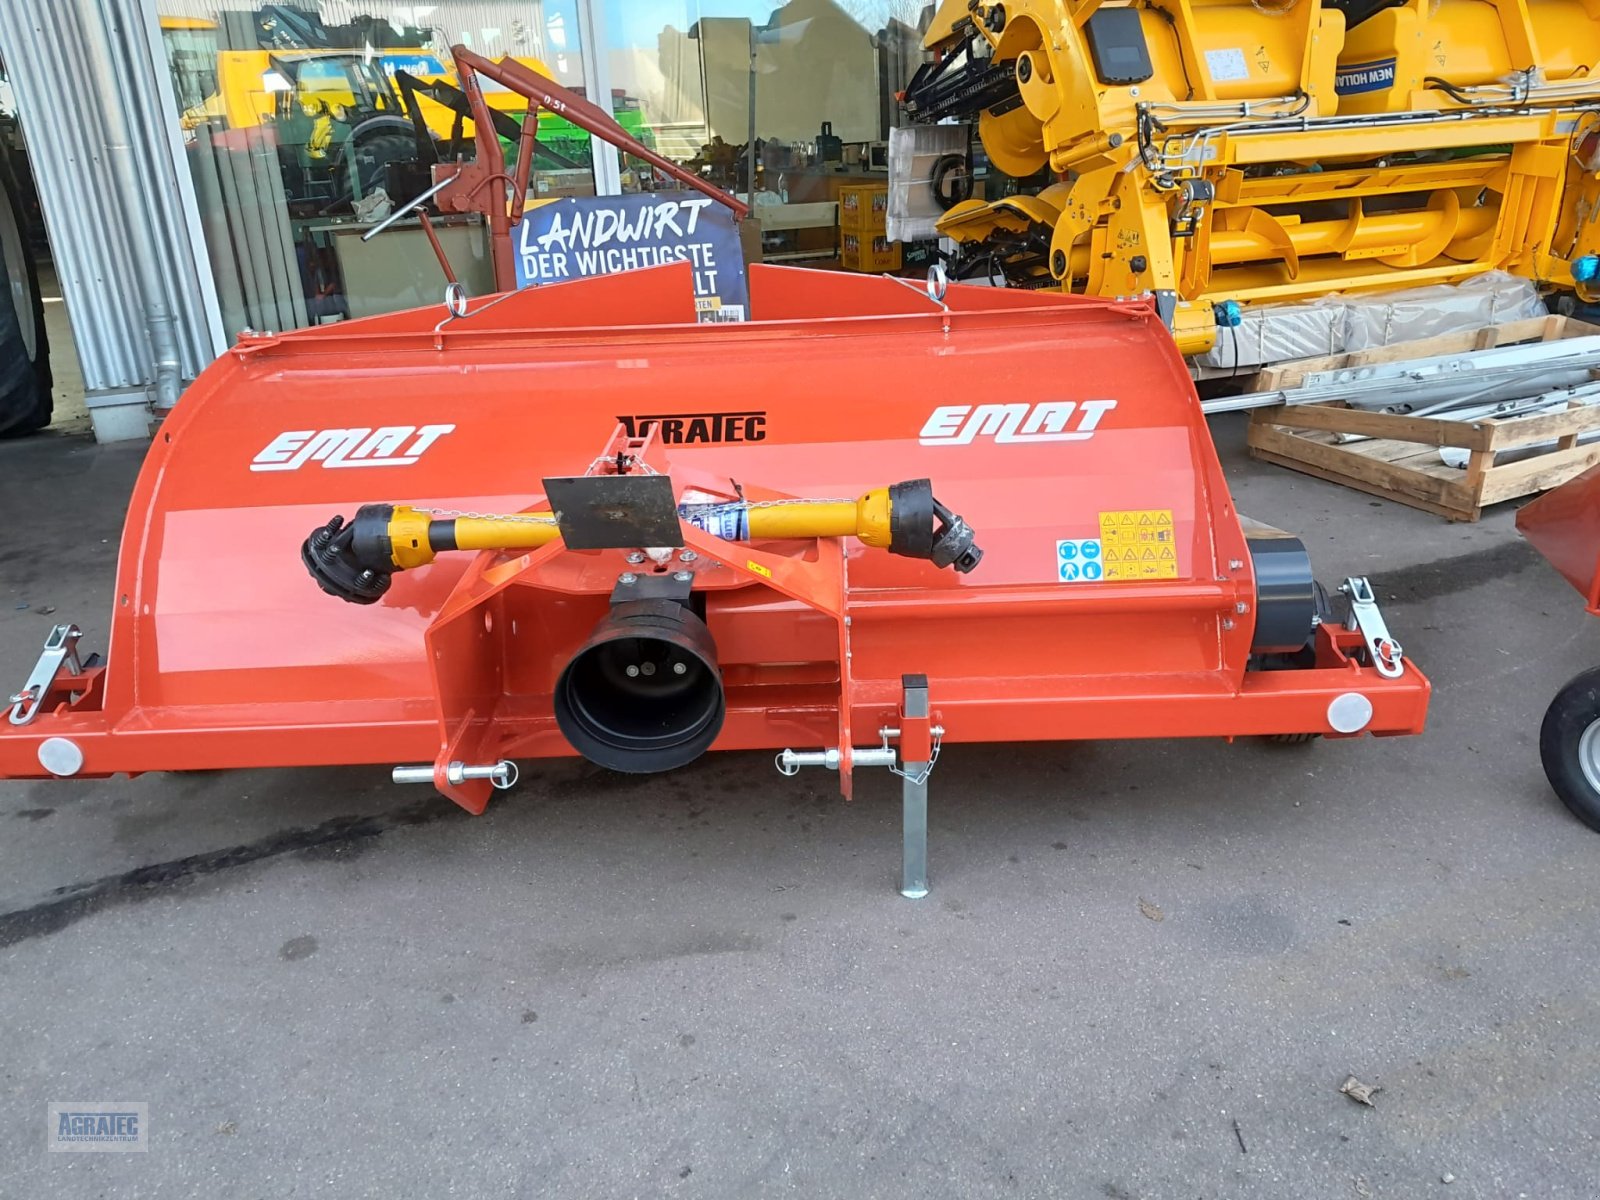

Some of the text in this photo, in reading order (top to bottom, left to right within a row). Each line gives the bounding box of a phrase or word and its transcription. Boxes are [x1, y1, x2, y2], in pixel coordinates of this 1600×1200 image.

[1368, 67, 1393, 83] NEW
[519, 198, 713, 256] LANDWIRT
[523, 243, 716, 279] DER WICHTIGSTE
[918, 399, 1118, 446] EMAT
[249, 423, 456, 472] EMAT
